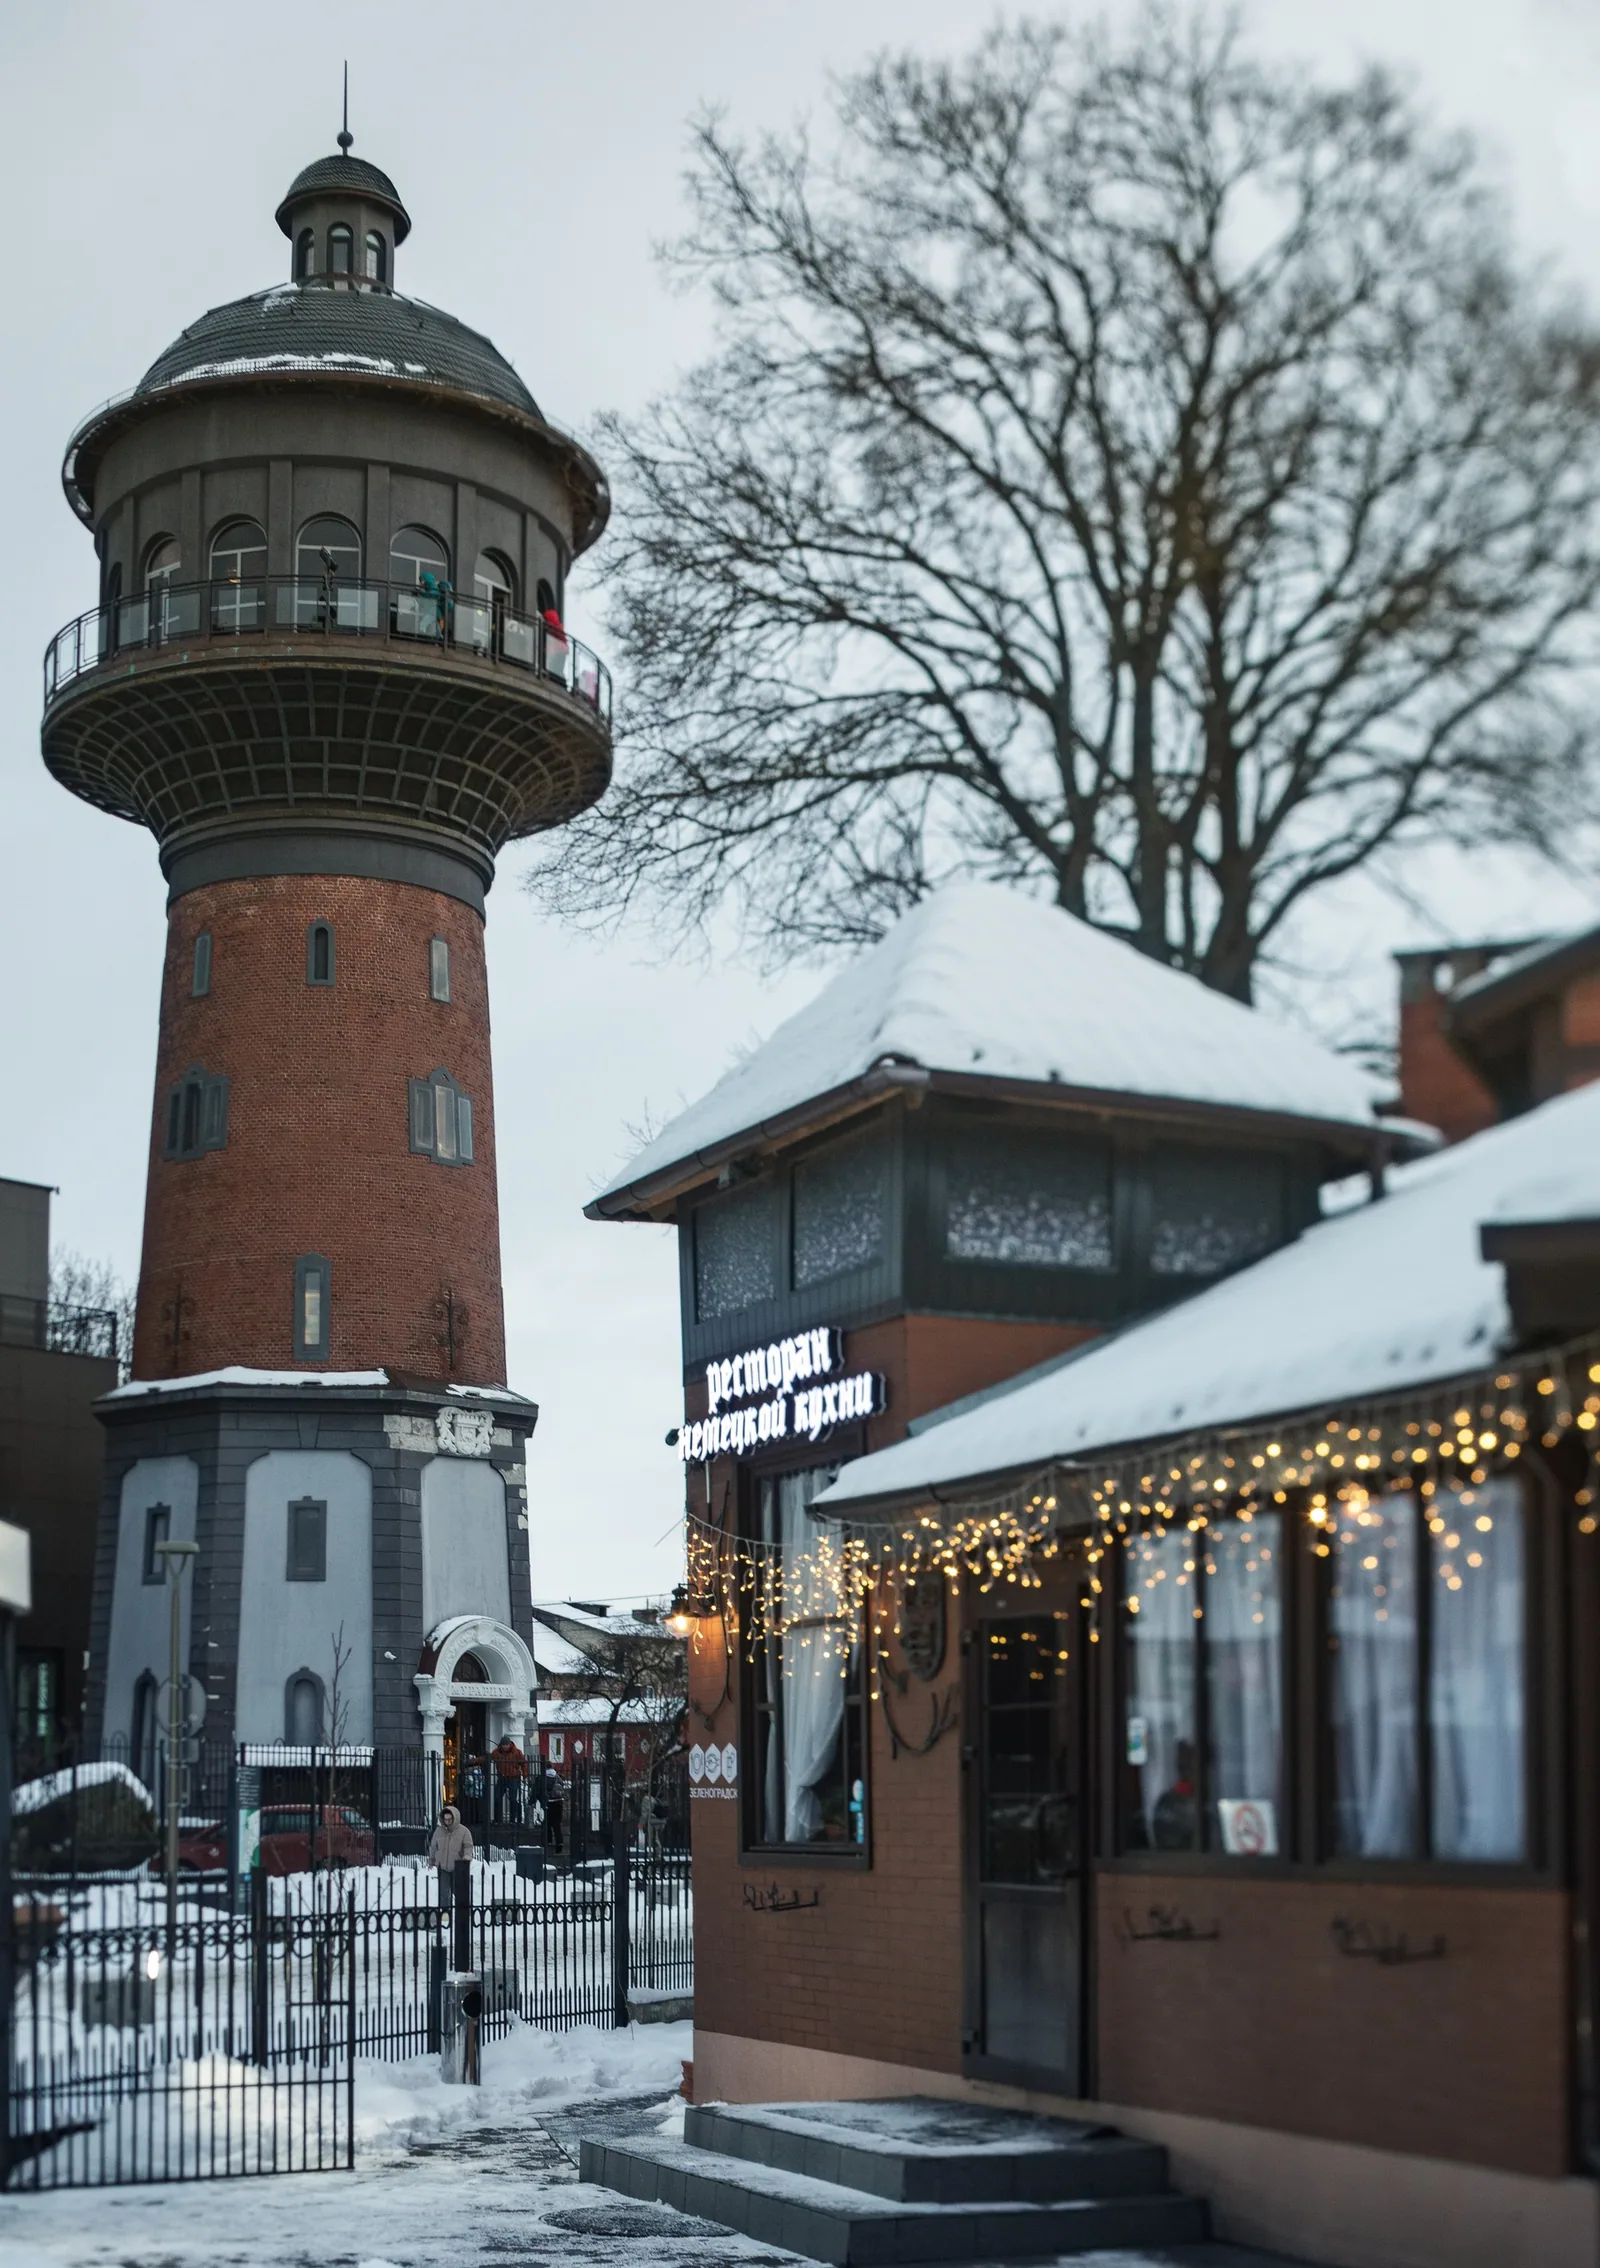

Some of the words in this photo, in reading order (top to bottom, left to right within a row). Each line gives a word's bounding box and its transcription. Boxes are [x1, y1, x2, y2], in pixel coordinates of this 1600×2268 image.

[705, 1326, 832, 1414] ресторан
[677, 1388, 787, 1461] немецкой
[793, 1371, 873, 1441] кухни
